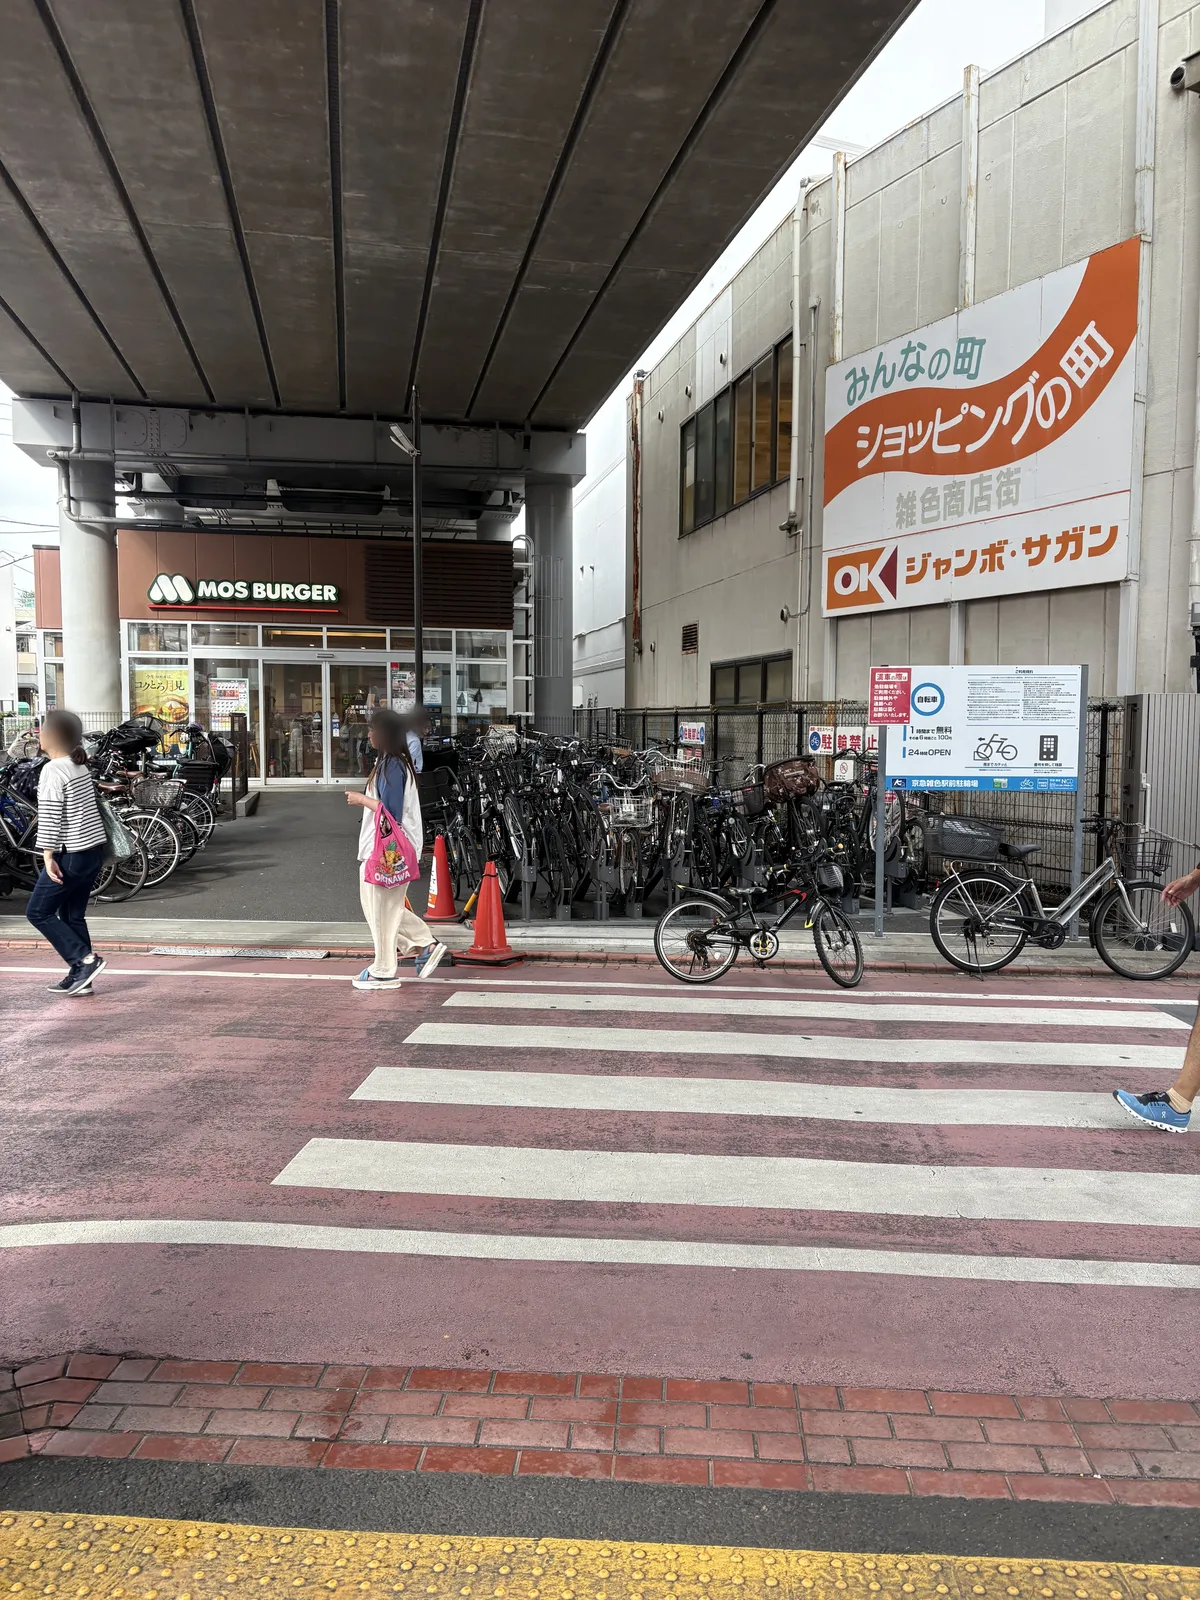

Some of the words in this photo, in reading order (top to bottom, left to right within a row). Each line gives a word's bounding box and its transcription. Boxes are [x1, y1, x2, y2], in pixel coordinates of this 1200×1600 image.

[844, 336, 986, 407] みんなの町
[856, 320, 1114, 469] ショッピングの町
[895, 467, 1021, 529] 雑色商店街
[834, 553, 890, 599] OK
[905, 525, 1119, 585] ジャンボ・サガン
[198, 581, 249, 599] MOS
[252, 583, 337, 601] BURGER
[135, 680, 185, 694] コクとろ月見
[911, 779, 979, 788] 京急雑色駅前駐輪場
[374, 870, 411, 885] OKINAWA
